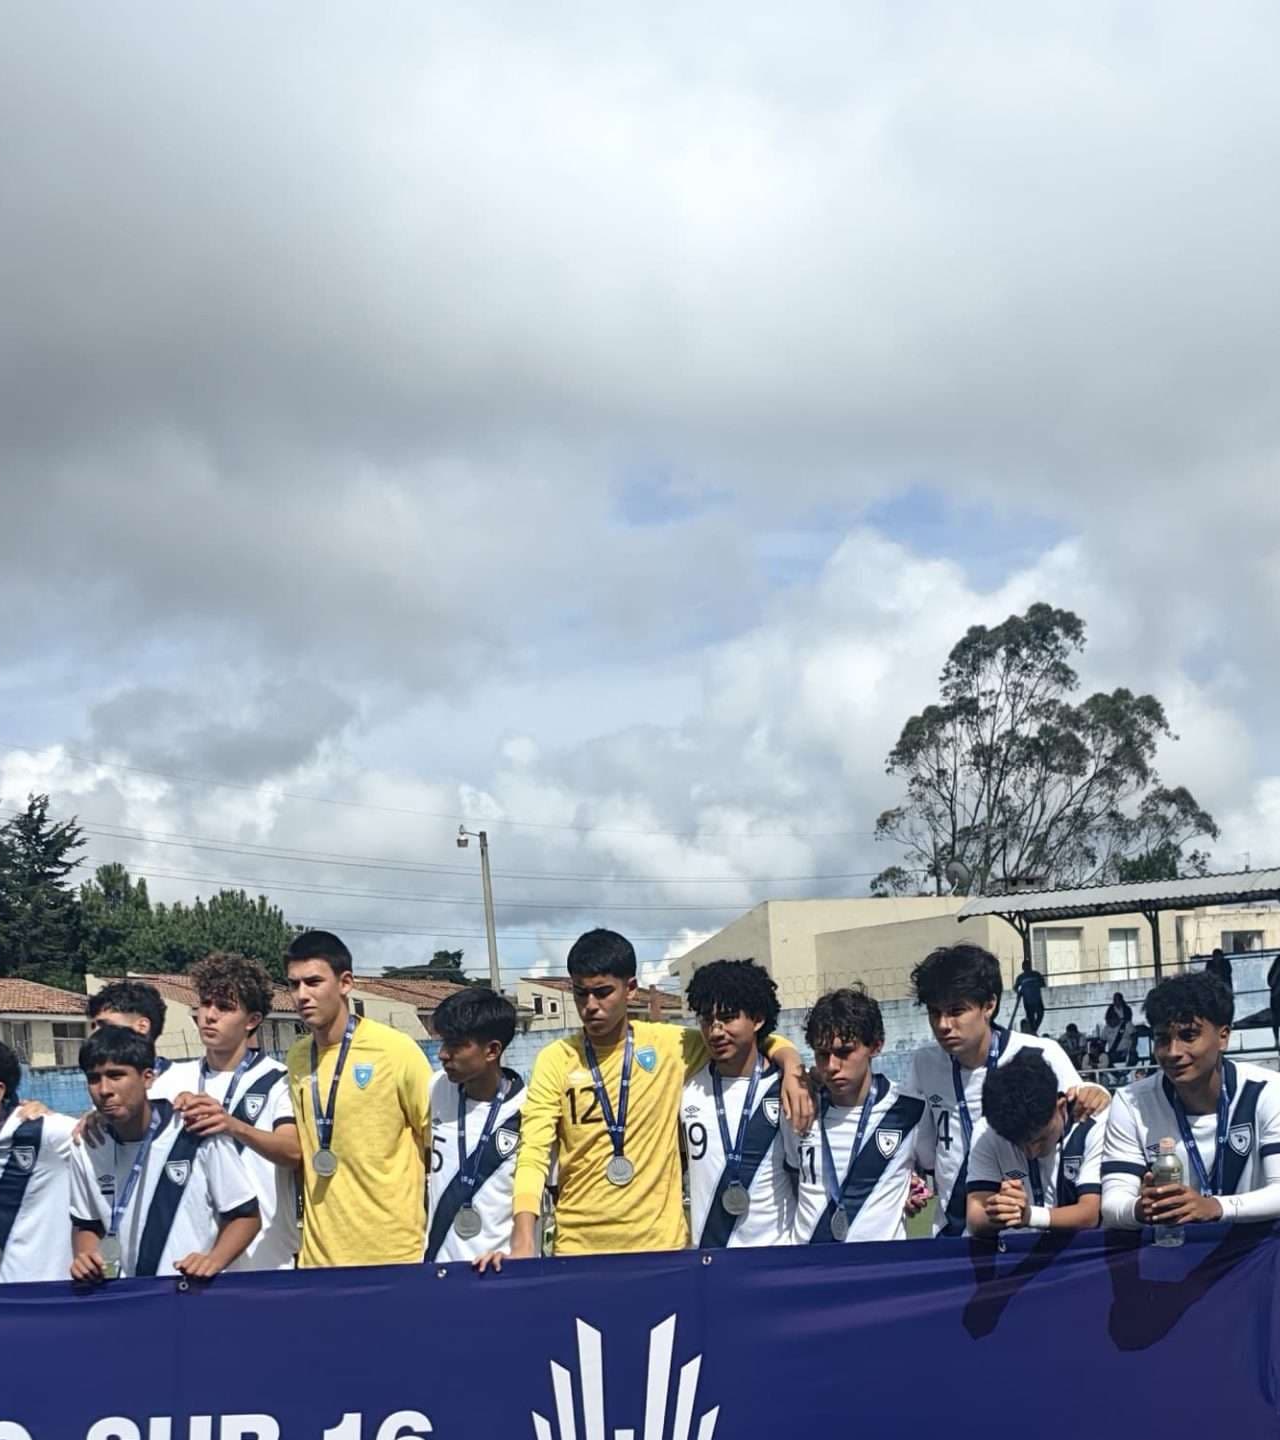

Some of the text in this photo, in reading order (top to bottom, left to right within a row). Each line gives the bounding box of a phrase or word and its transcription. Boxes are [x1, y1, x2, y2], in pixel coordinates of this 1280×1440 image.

[565, 1085, 604, 1125] 12
[682, 1121, 708, 1161] 19
[797, 1145, 817, 1185] 11
